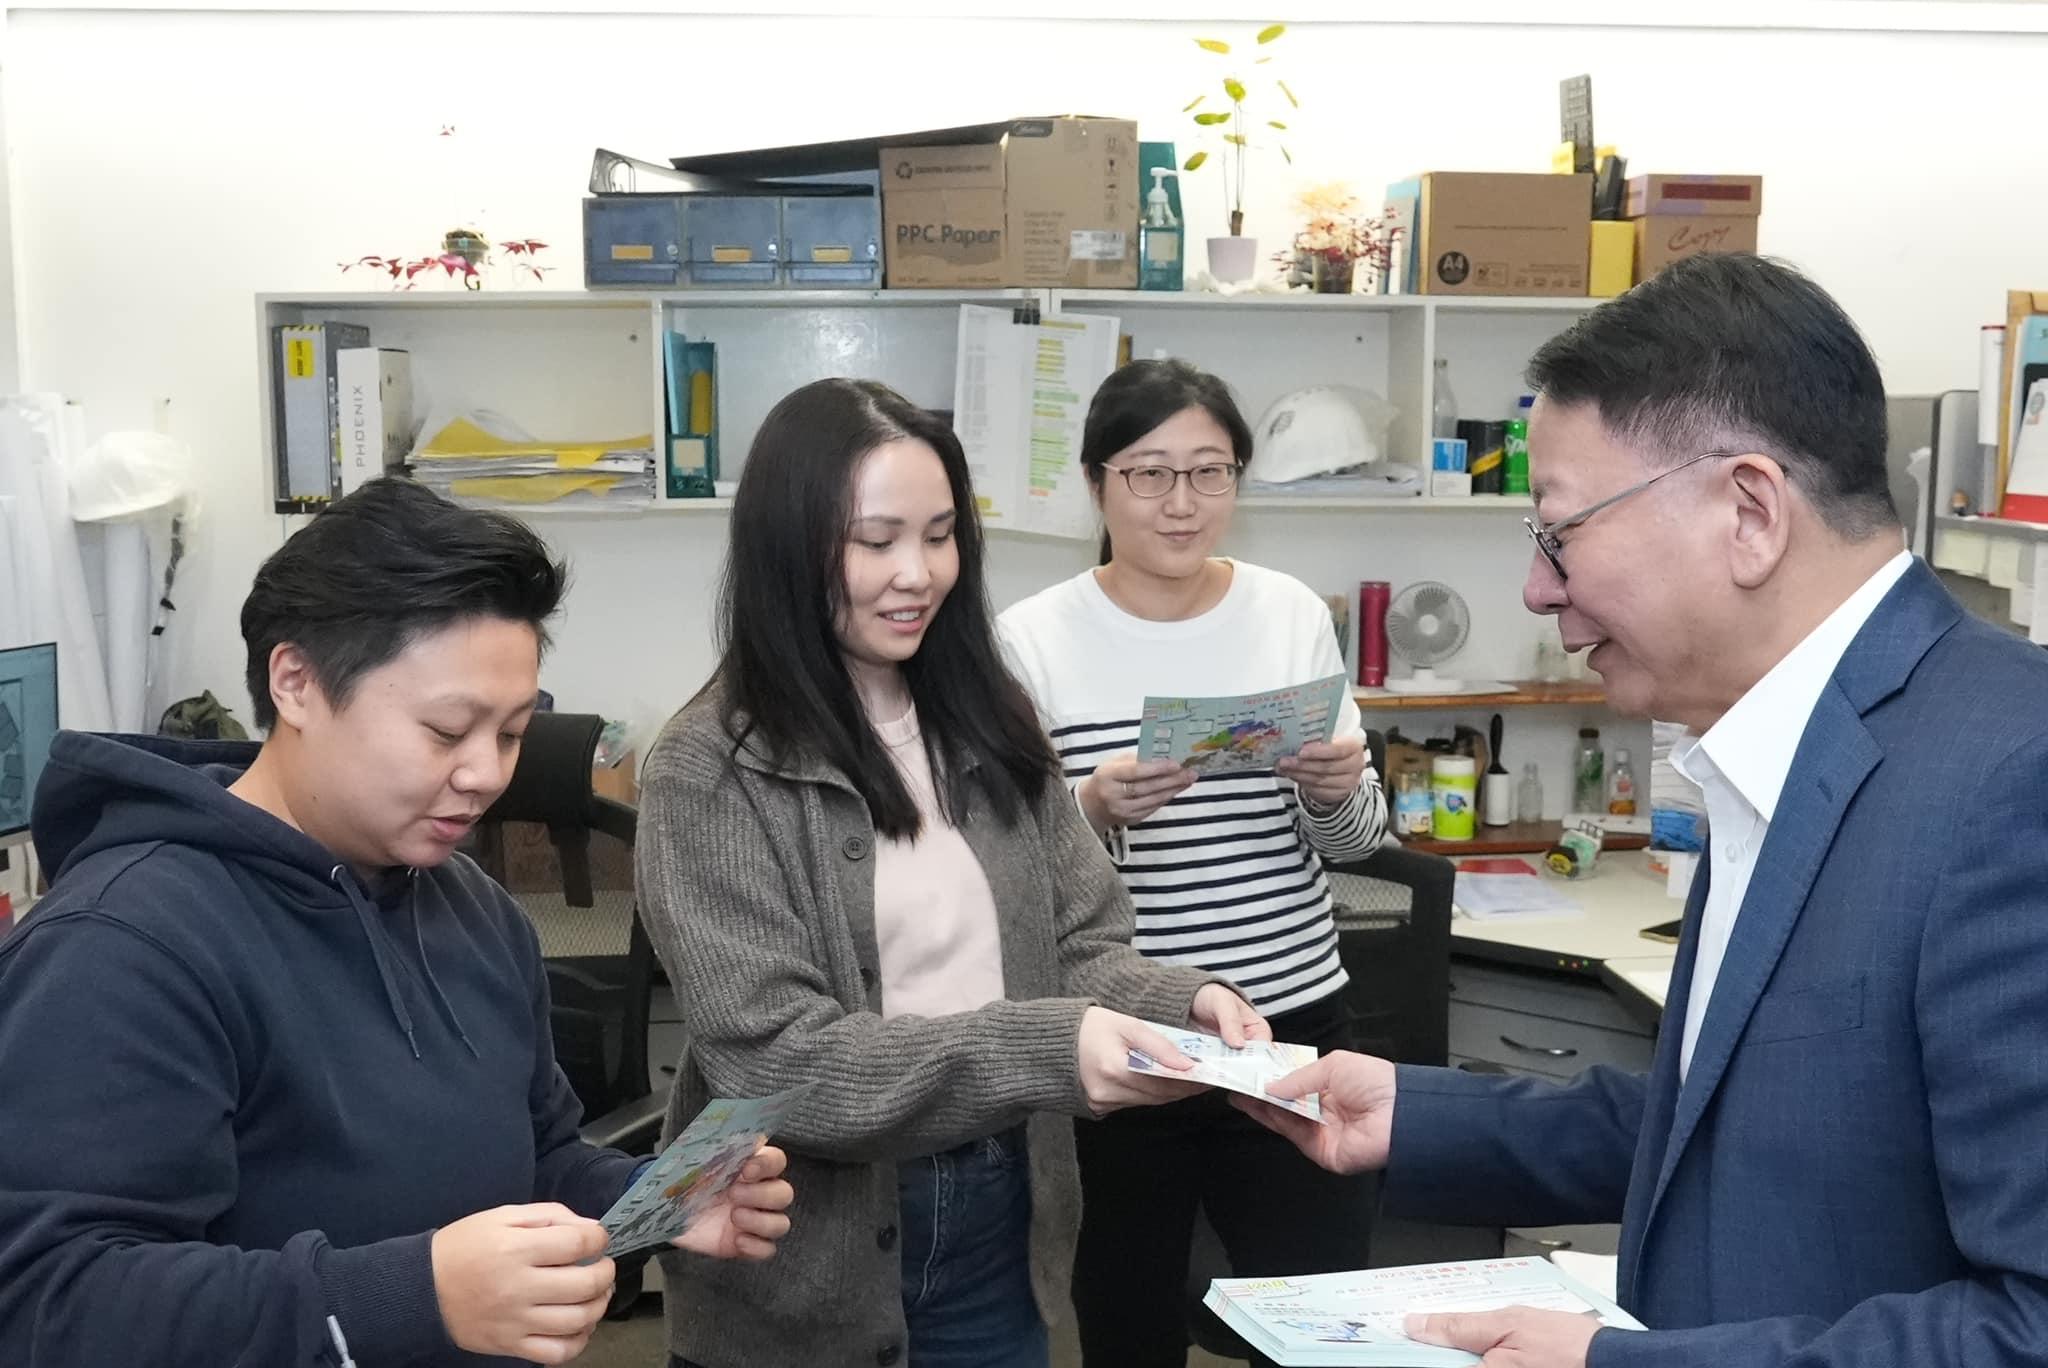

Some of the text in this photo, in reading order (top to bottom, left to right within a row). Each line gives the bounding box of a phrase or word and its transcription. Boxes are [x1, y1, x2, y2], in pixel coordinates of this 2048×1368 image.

[897, 224, 1001, 248] PPC Paper
[1443, 255, 1464, 270] A4
[353, 385, 366, 468] PHOENIX
